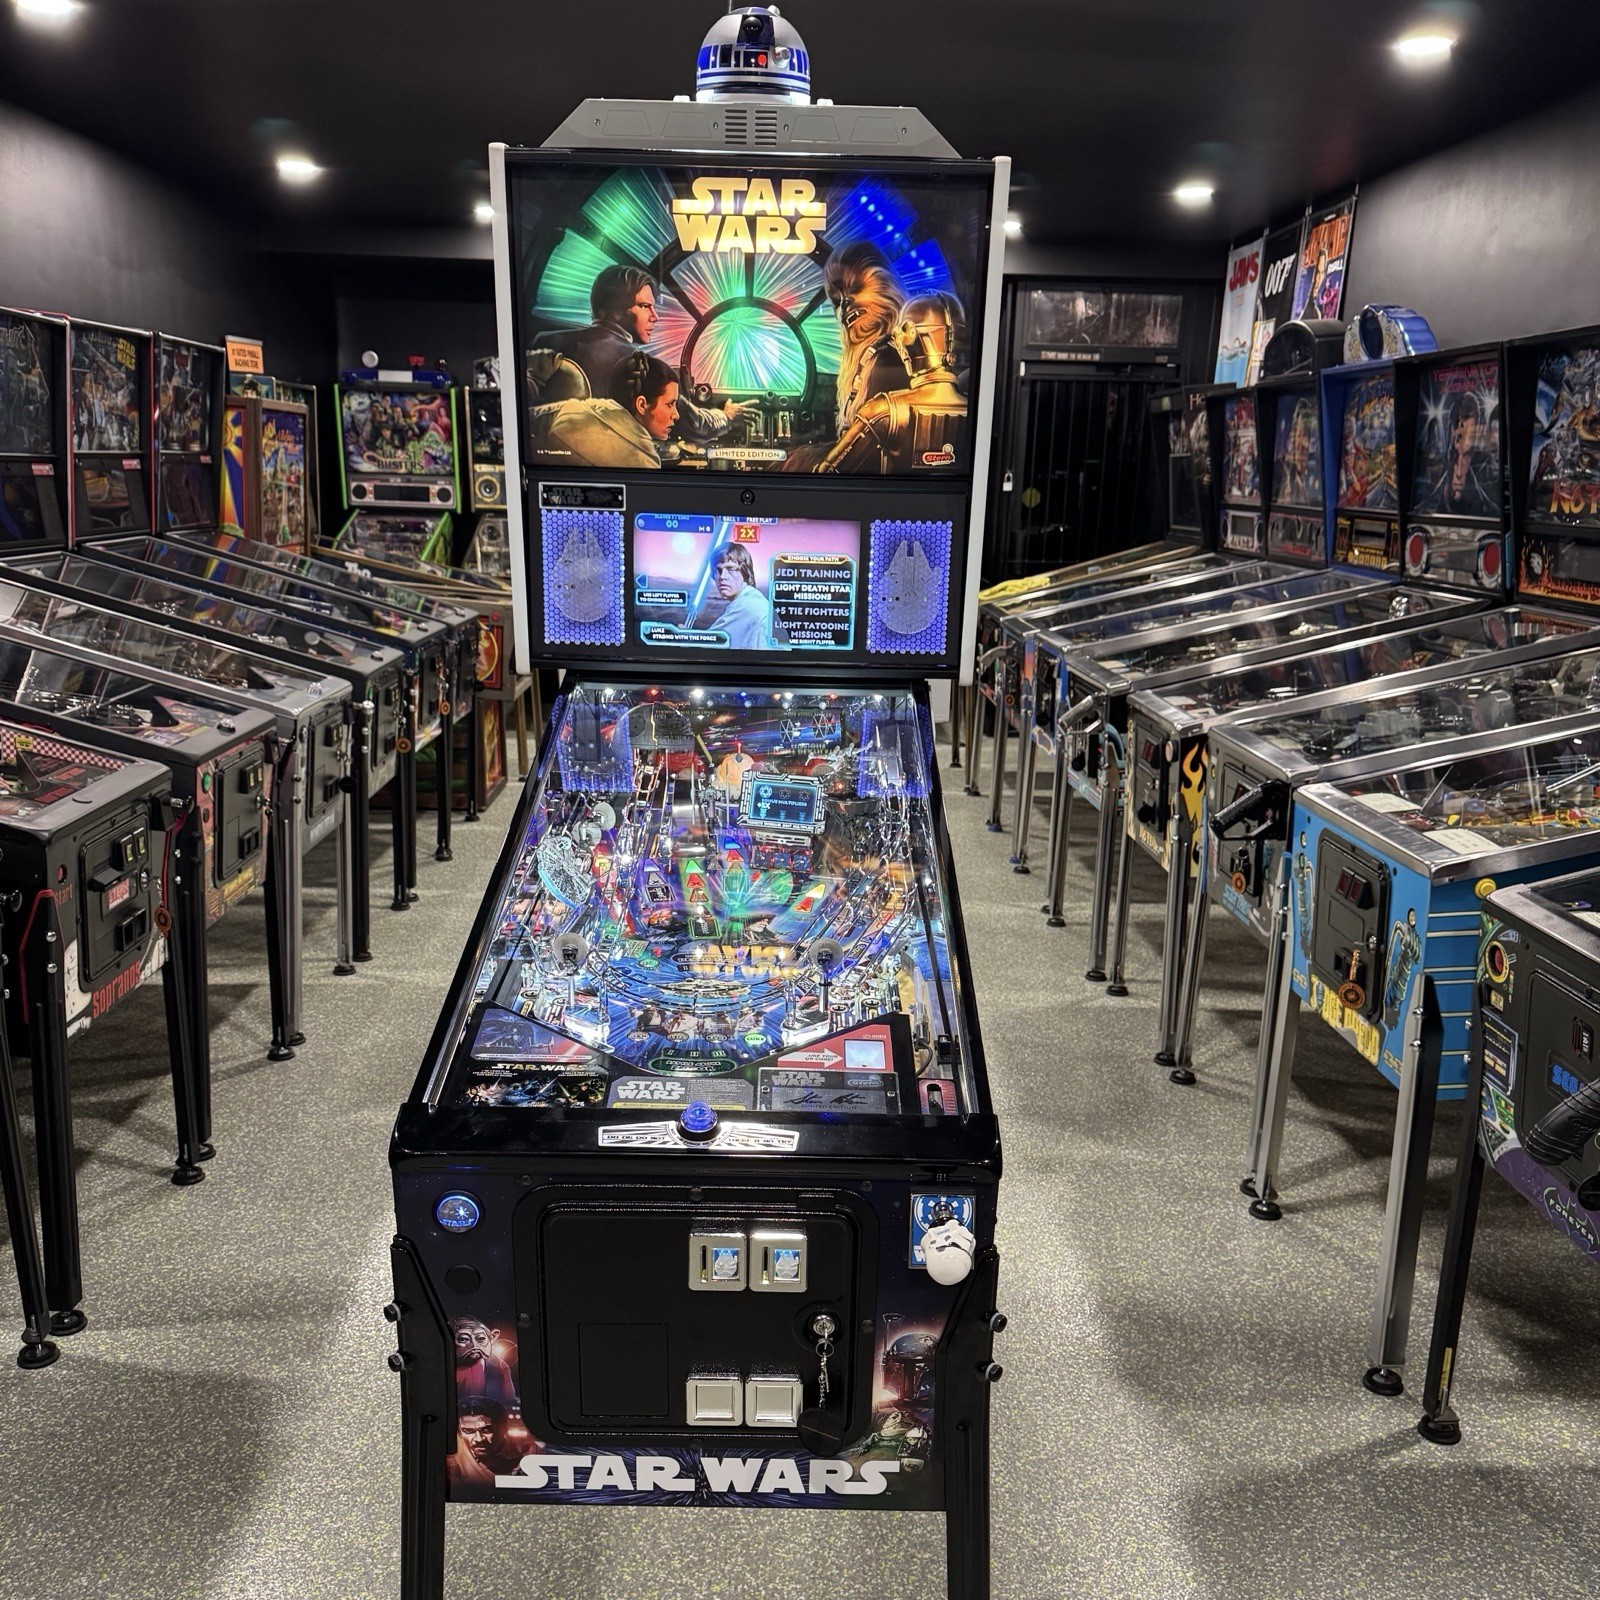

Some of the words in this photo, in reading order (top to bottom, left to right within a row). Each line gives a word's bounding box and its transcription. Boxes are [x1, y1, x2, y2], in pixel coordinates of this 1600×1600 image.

[673, 177, 826, 216] STAR
[673, 214, 826, 254] WARS
[1229, 251, 1259, 292] JAWS
[1265, 253, 1296, 298] 007
[116, 338, 136, 359] STAR
[116, 349, 136, 371] WARS
[714, 451, 747, 460] LIMITED
[748, 451, 782, 460] EDITION
[377, 460, 424, 470] BUSTERS
[740, 529, 755, 538] 2X
[776, 568, 797, 577] JEDI
[800, 569, 850, 579] TRAINING
[805, 608, 849, 616] FIGHTERS
[803, 622, 849, 630] TATOOINE
[791, 631, 832, 639] MISSIONS
[772, 1072, 825, 1081] STAR
[1552, 1064, 1586, 1094] SEG
[618, 1080, 685, 1091] STAR
[618, 1090, 685, 1100] WARS
[1550, 1198, 1594, 1245] FOREVER
[494, 1454, 695, 1492] STAR
[700, 1458, 900, 1496] WARS
